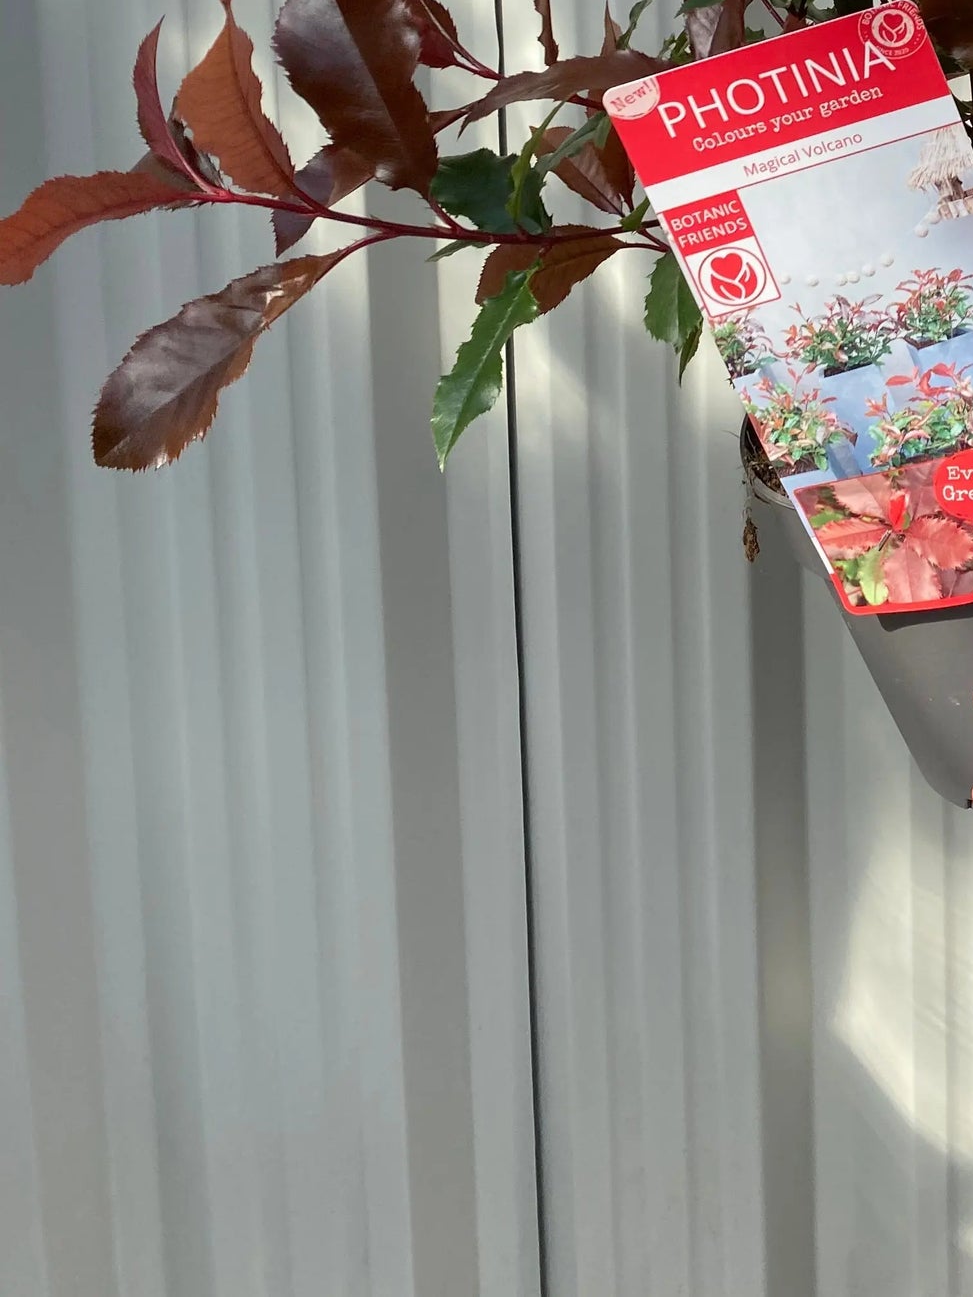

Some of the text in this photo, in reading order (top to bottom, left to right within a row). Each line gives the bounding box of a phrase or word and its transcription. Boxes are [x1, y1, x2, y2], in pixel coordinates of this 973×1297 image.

[657, 39, 897, 139] PHOTINIA
[692, 86, 883, 152] Colours your garden
[743, 133, 863, 177] Magical Volcano
[670, 200, 740, 232] BOTANIC
[678, 217, 748, 248] FRIENDS
